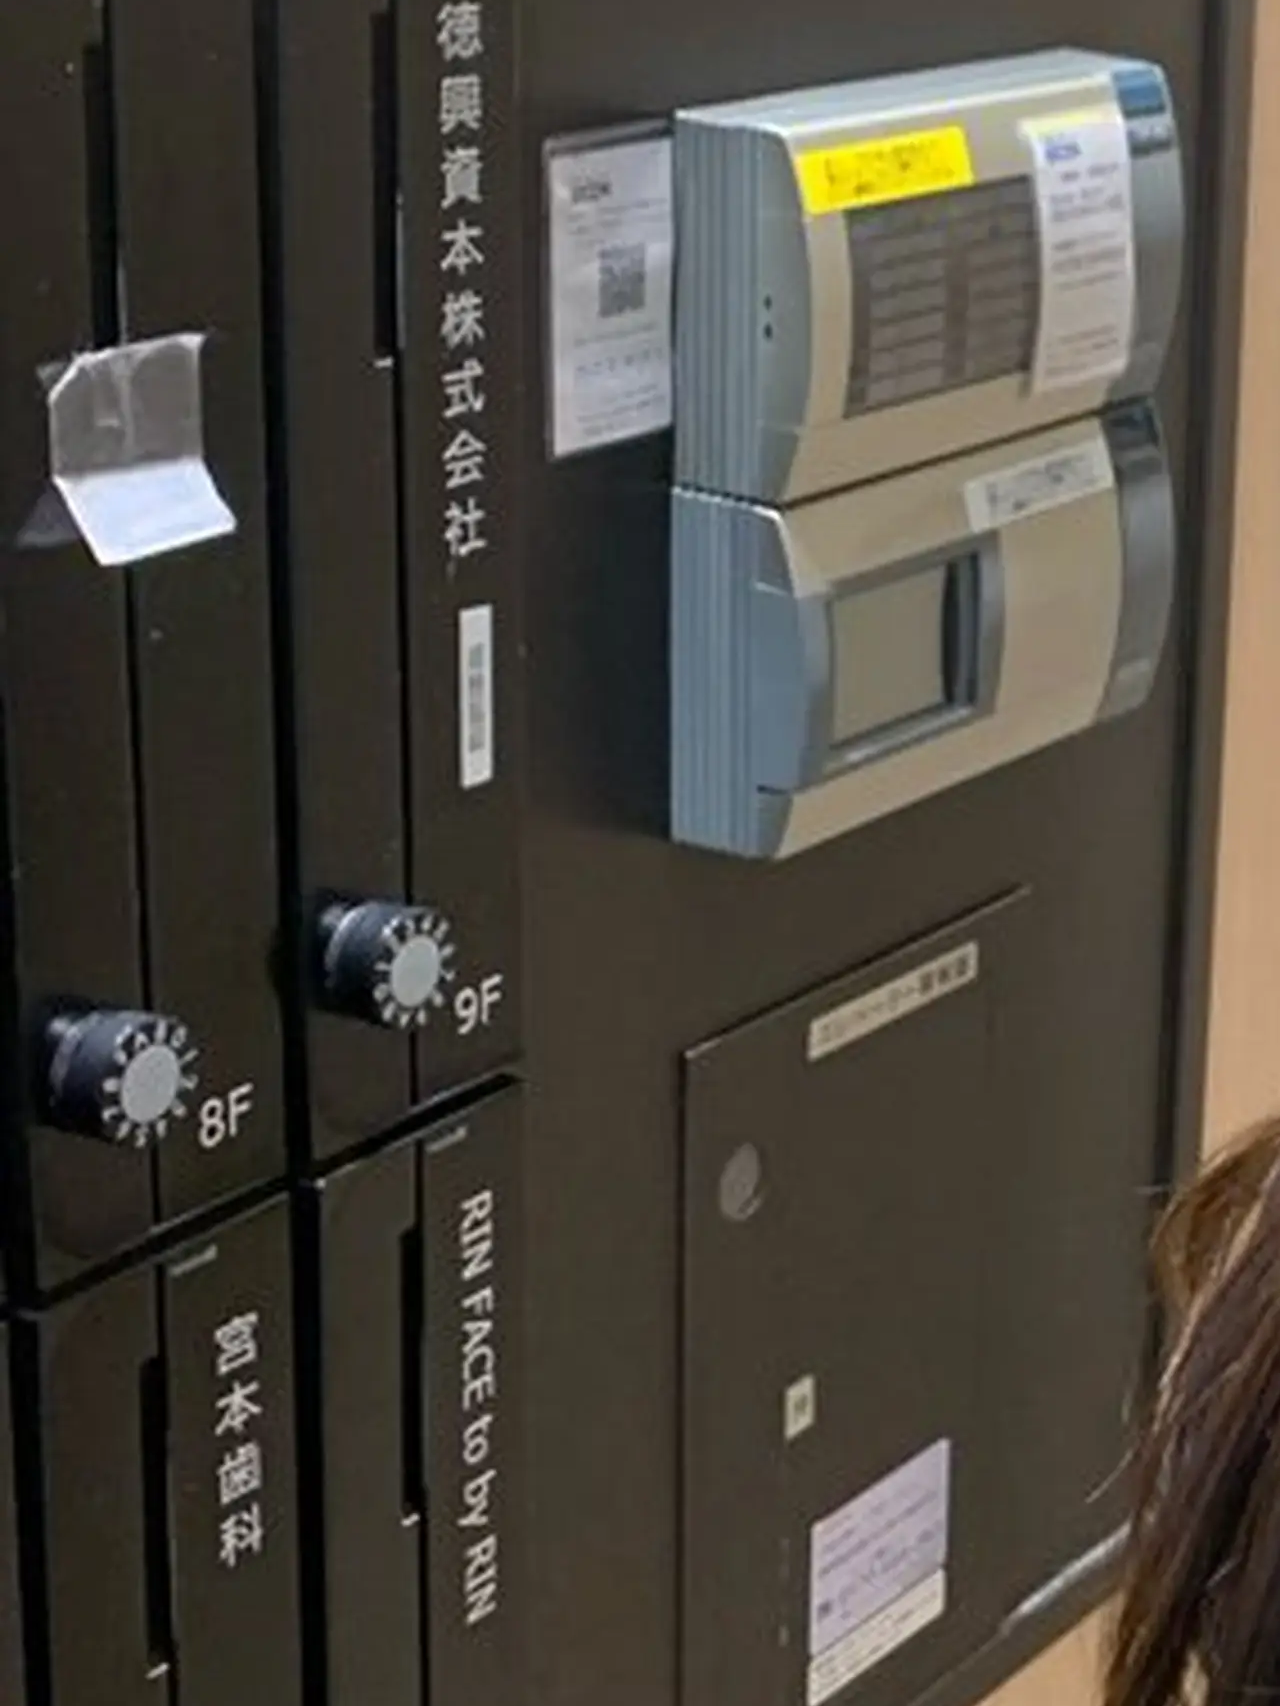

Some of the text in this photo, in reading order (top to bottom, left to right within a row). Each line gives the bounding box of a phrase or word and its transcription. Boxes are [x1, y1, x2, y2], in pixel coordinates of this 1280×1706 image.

[453, 972, 503, 1035] 9F
[198, 1082, 254, 1148] 8F
[457, 1190, 498, 1625] RIN FACE to by RIN
